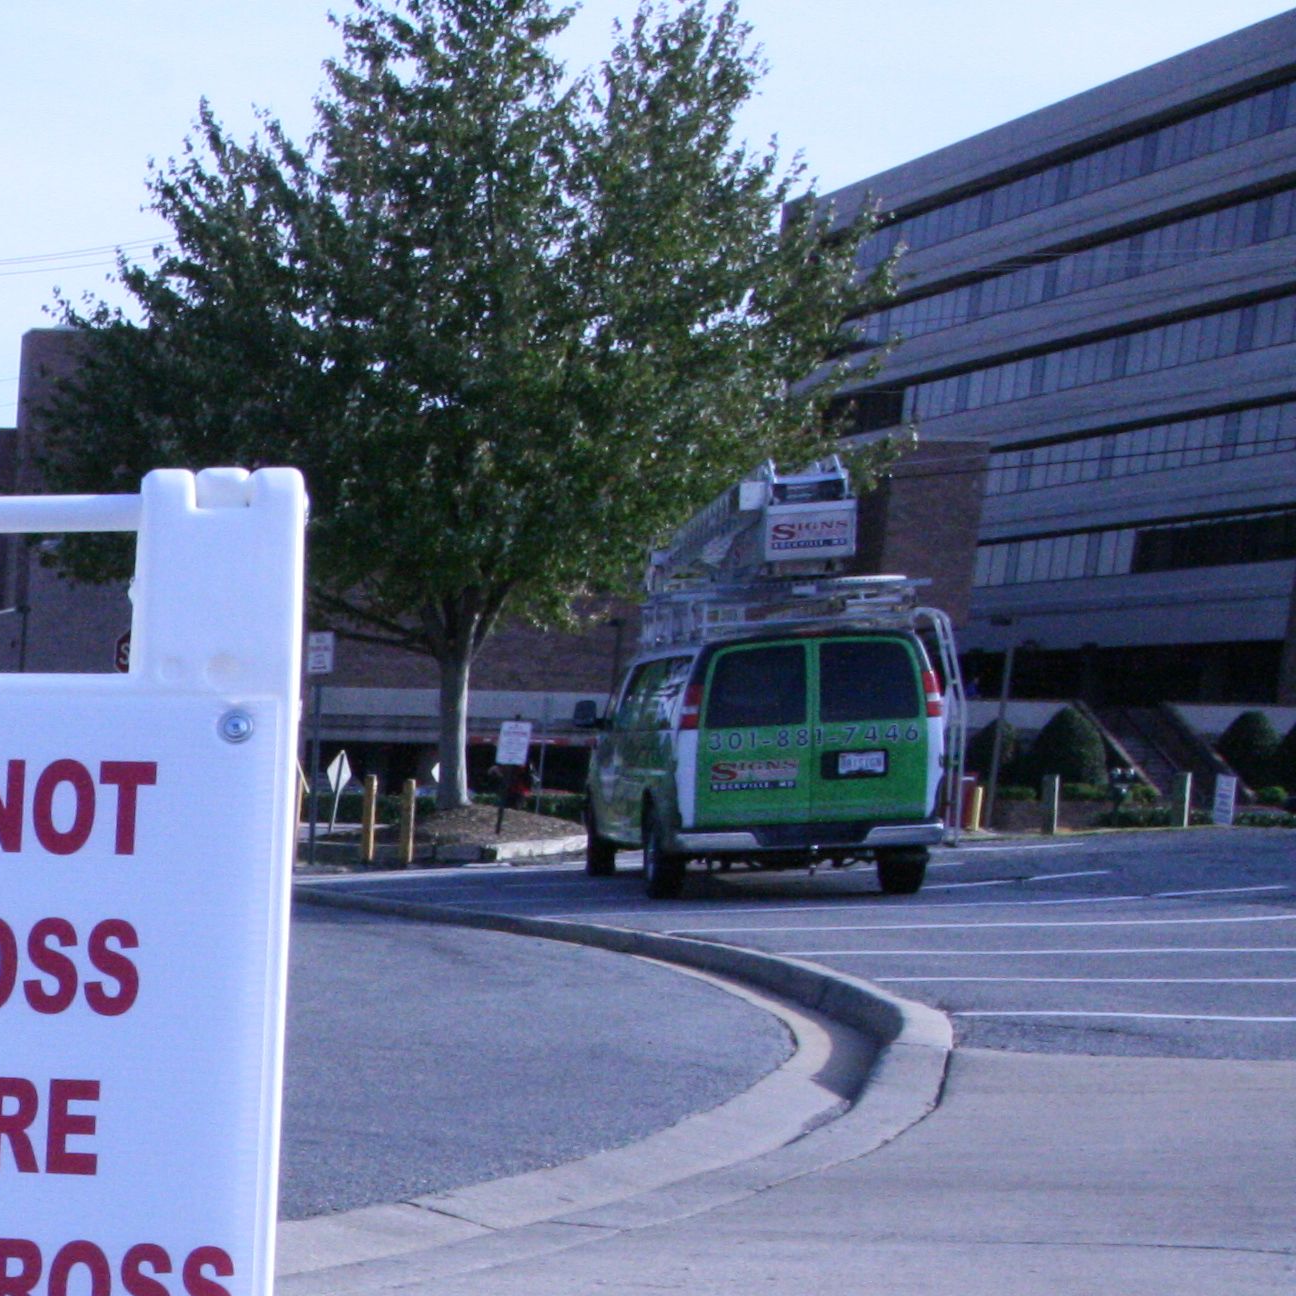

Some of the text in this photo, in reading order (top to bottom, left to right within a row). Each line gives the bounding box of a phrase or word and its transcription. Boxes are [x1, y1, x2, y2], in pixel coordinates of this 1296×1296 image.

[772, 520, 849, 540] SIGNS
[709, 724, 919, 750] 301-881-7446
[711, 760, 798, 782] SIGNS
